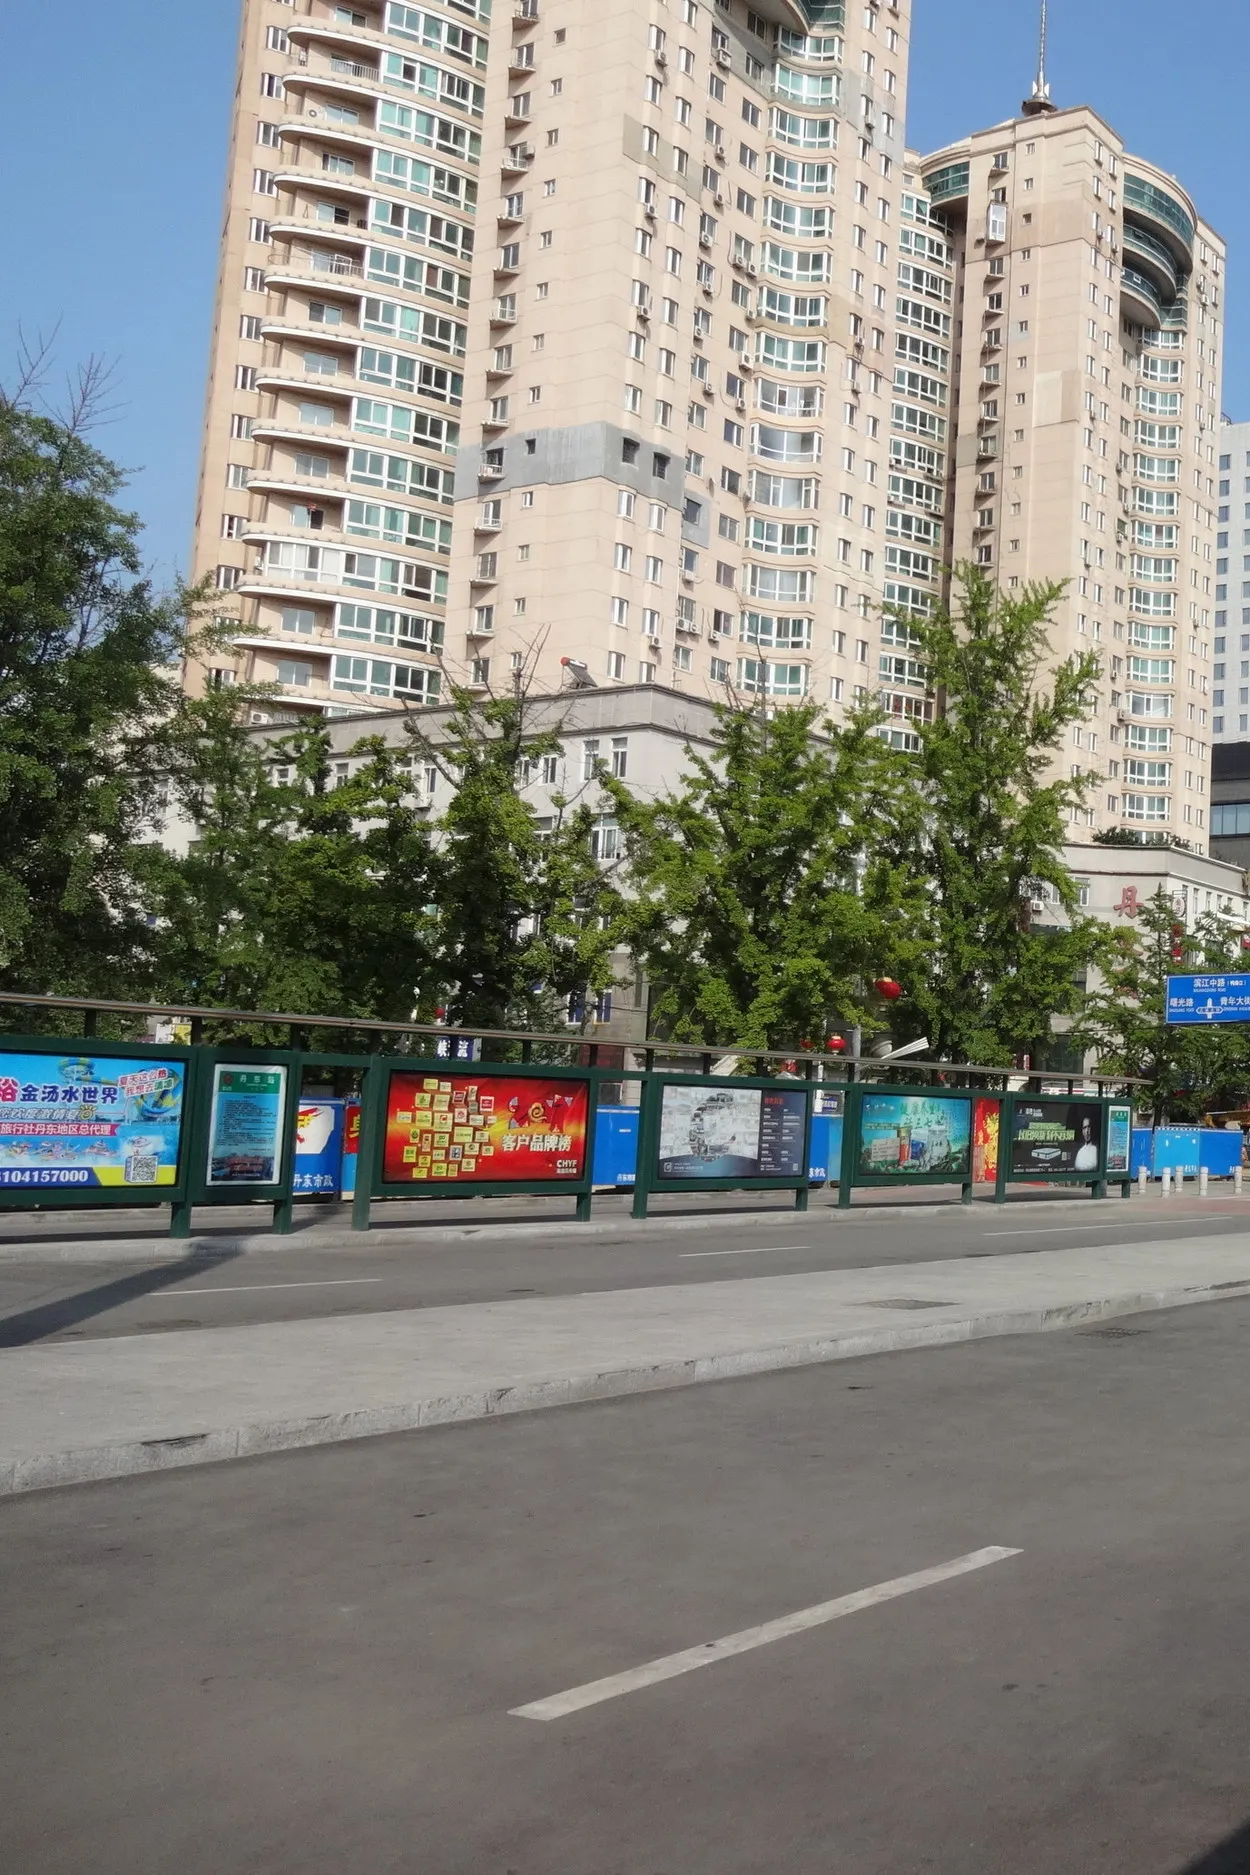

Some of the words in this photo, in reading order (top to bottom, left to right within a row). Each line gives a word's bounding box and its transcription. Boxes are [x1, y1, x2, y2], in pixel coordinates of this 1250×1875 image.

[1113, 886, 1145, 919] 丹
[1193, 978, 1225, 988] 滨江中路
[20, 1083, 119, 1105] 金汤水世界
[502, 1134, 572, 1152] 客户品牌榜
[556, 1159, 577, 1168] CHYF
[0, 1170, 89, 1183] 104157000
[293, 1173, 334, 1188] 丹东市政
